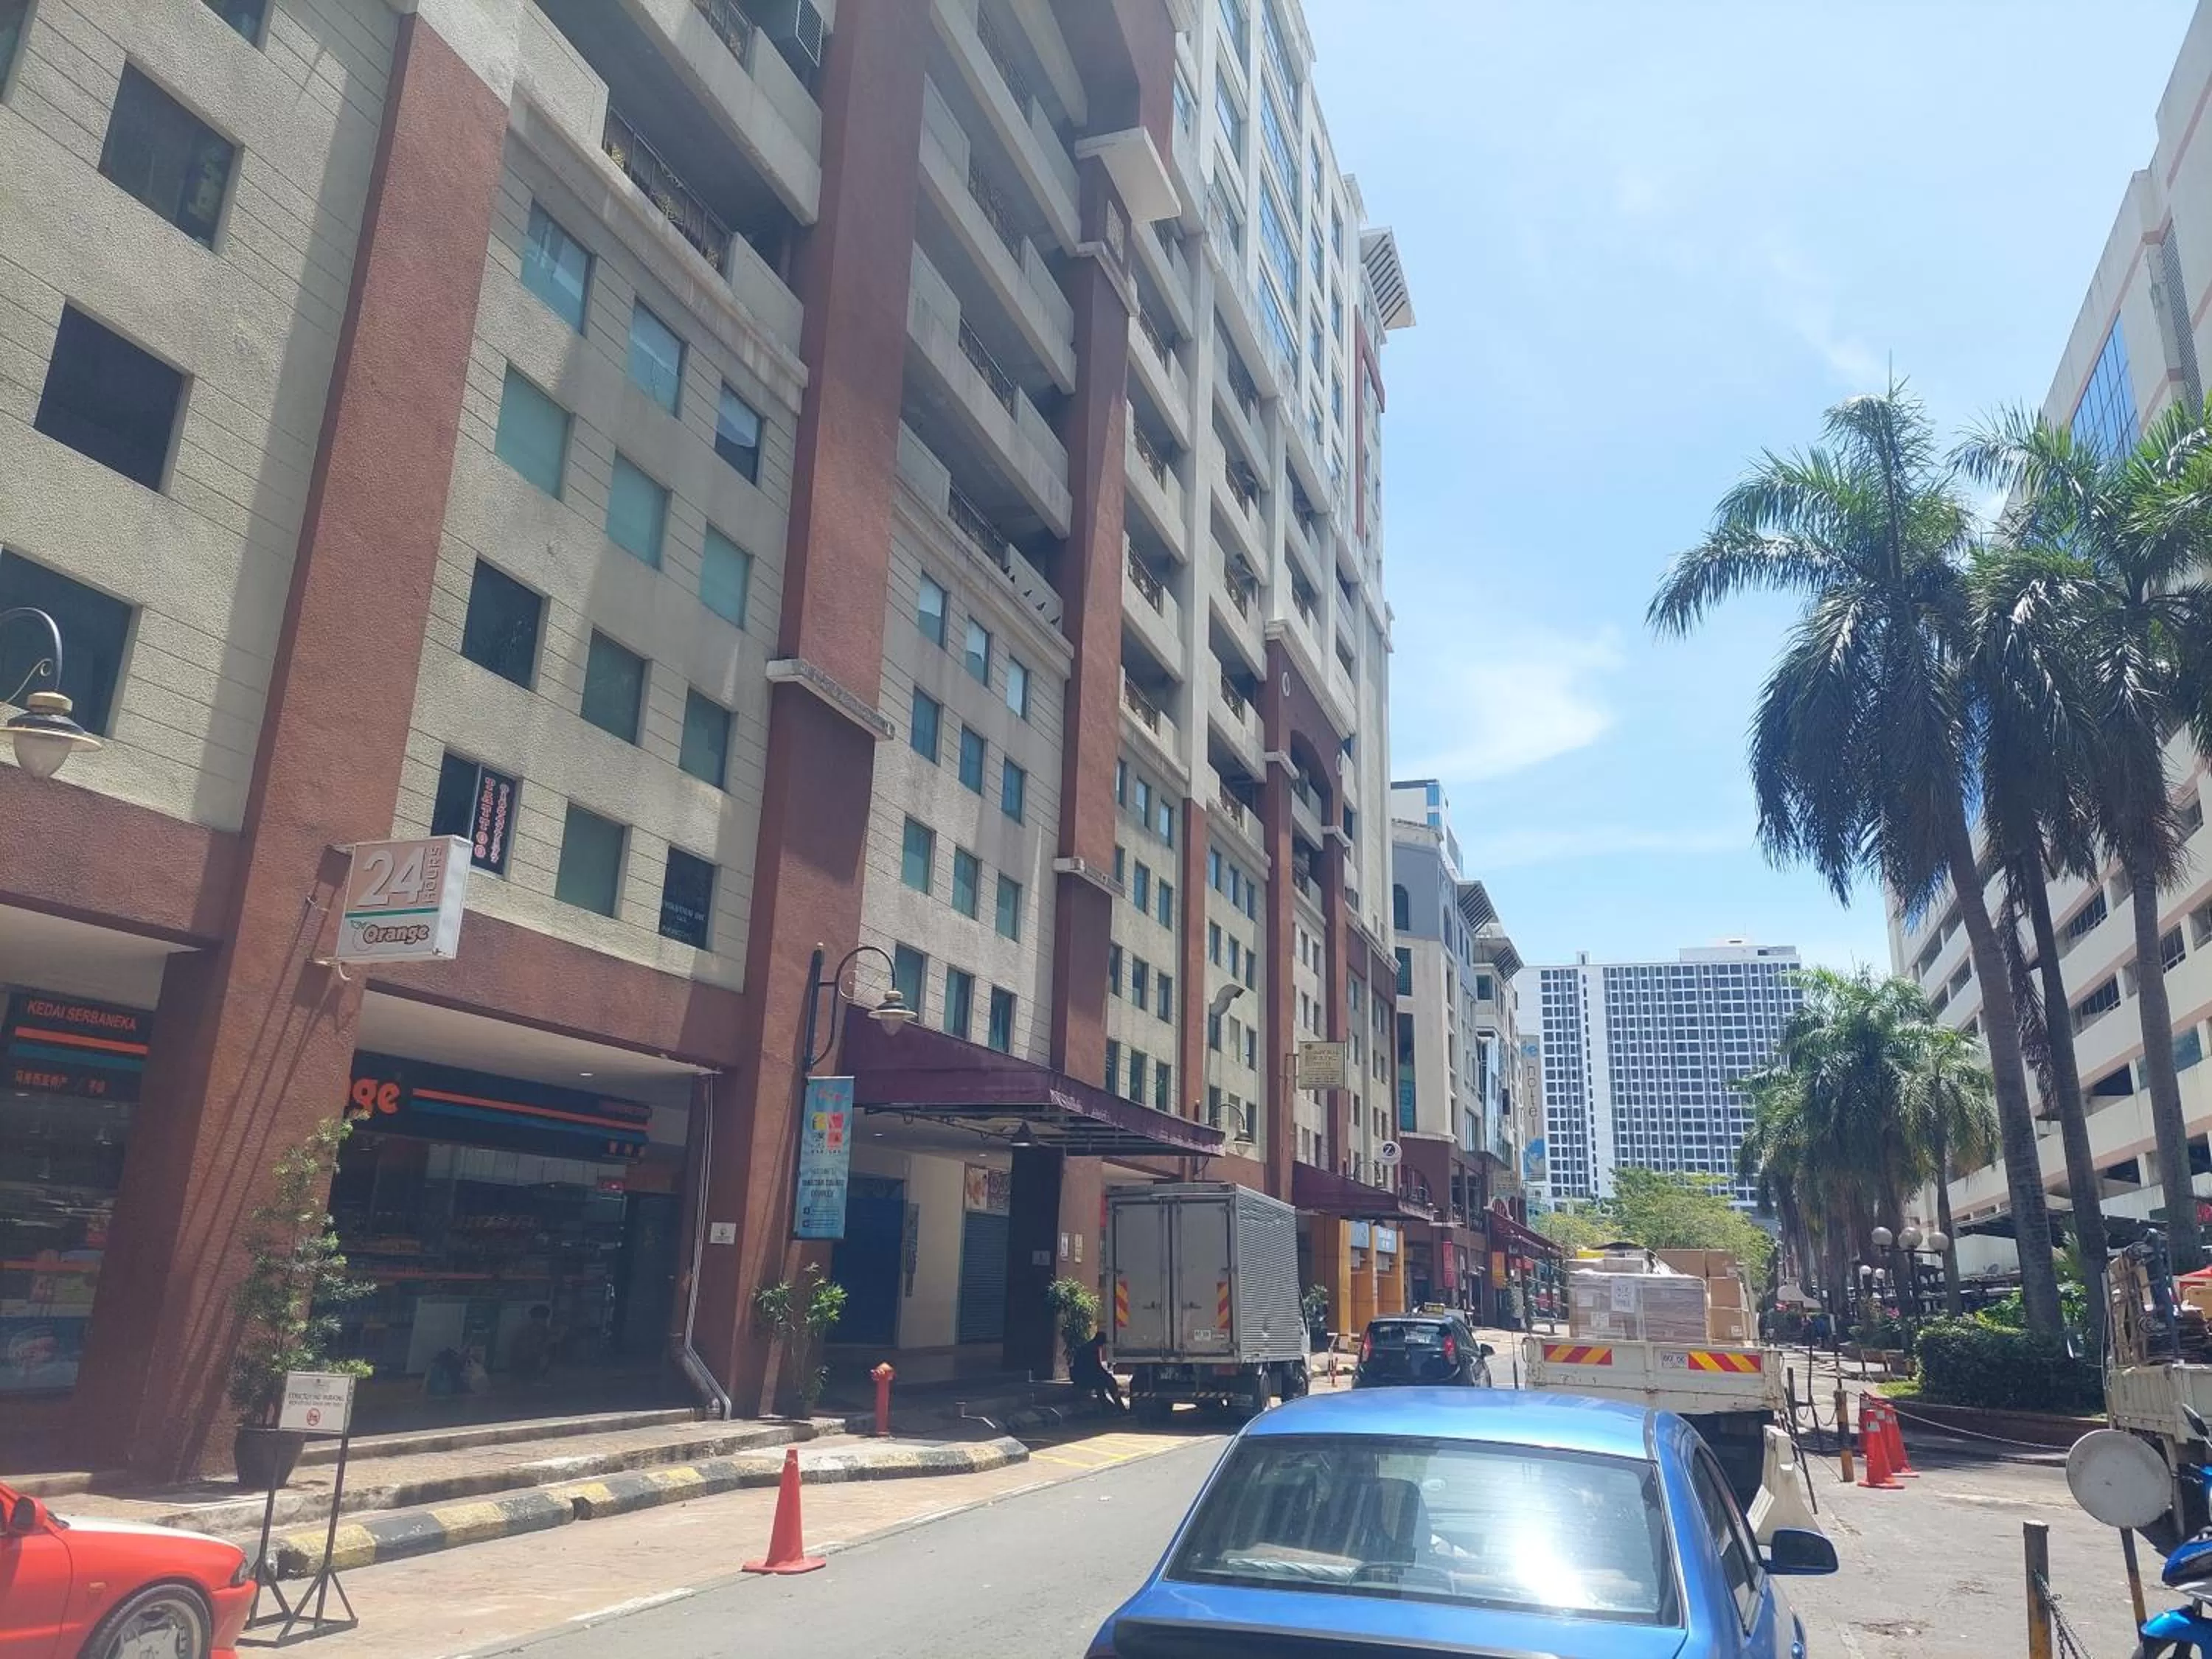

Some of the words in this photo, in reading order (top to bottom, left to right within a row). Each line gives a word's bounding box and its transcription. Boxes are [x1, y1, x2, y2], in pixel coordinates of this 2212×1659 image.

[355, 848, 426, 907] 24
[422, 846, 442, 903] HOURS
[363, 924, 430, 945] Orange
[27, 1001, 66, 1018] KEDAI
[67, 1007, 136, 1030] SERBANEKA
